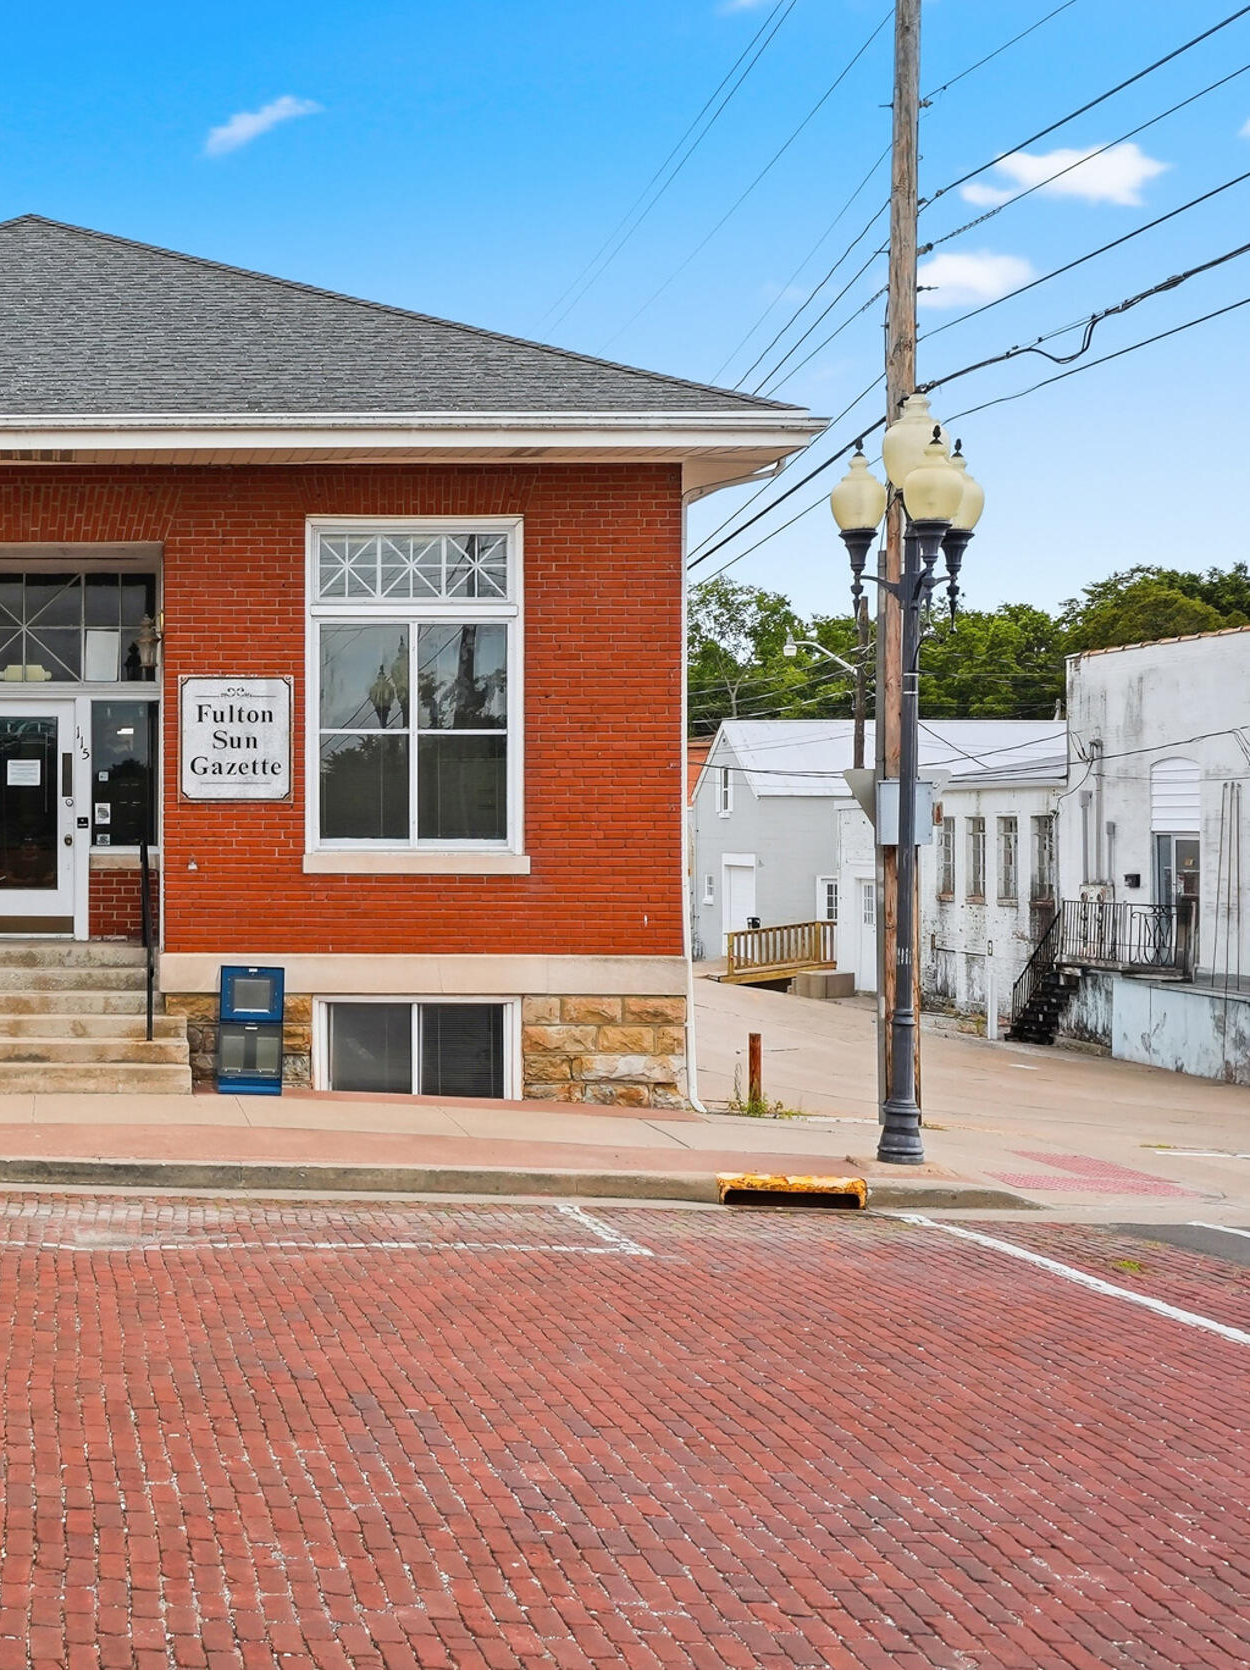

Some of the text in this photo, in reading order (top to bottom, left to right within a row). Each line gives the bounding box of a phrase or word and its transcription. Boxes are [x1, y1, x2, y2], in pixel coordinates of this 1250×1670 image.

[196, 704, 273, 723] Fulton
[76, 725, 90, 760] 115
[212, 730, 258, 750] Sun
[190, 756, 282, 776] Gazette
